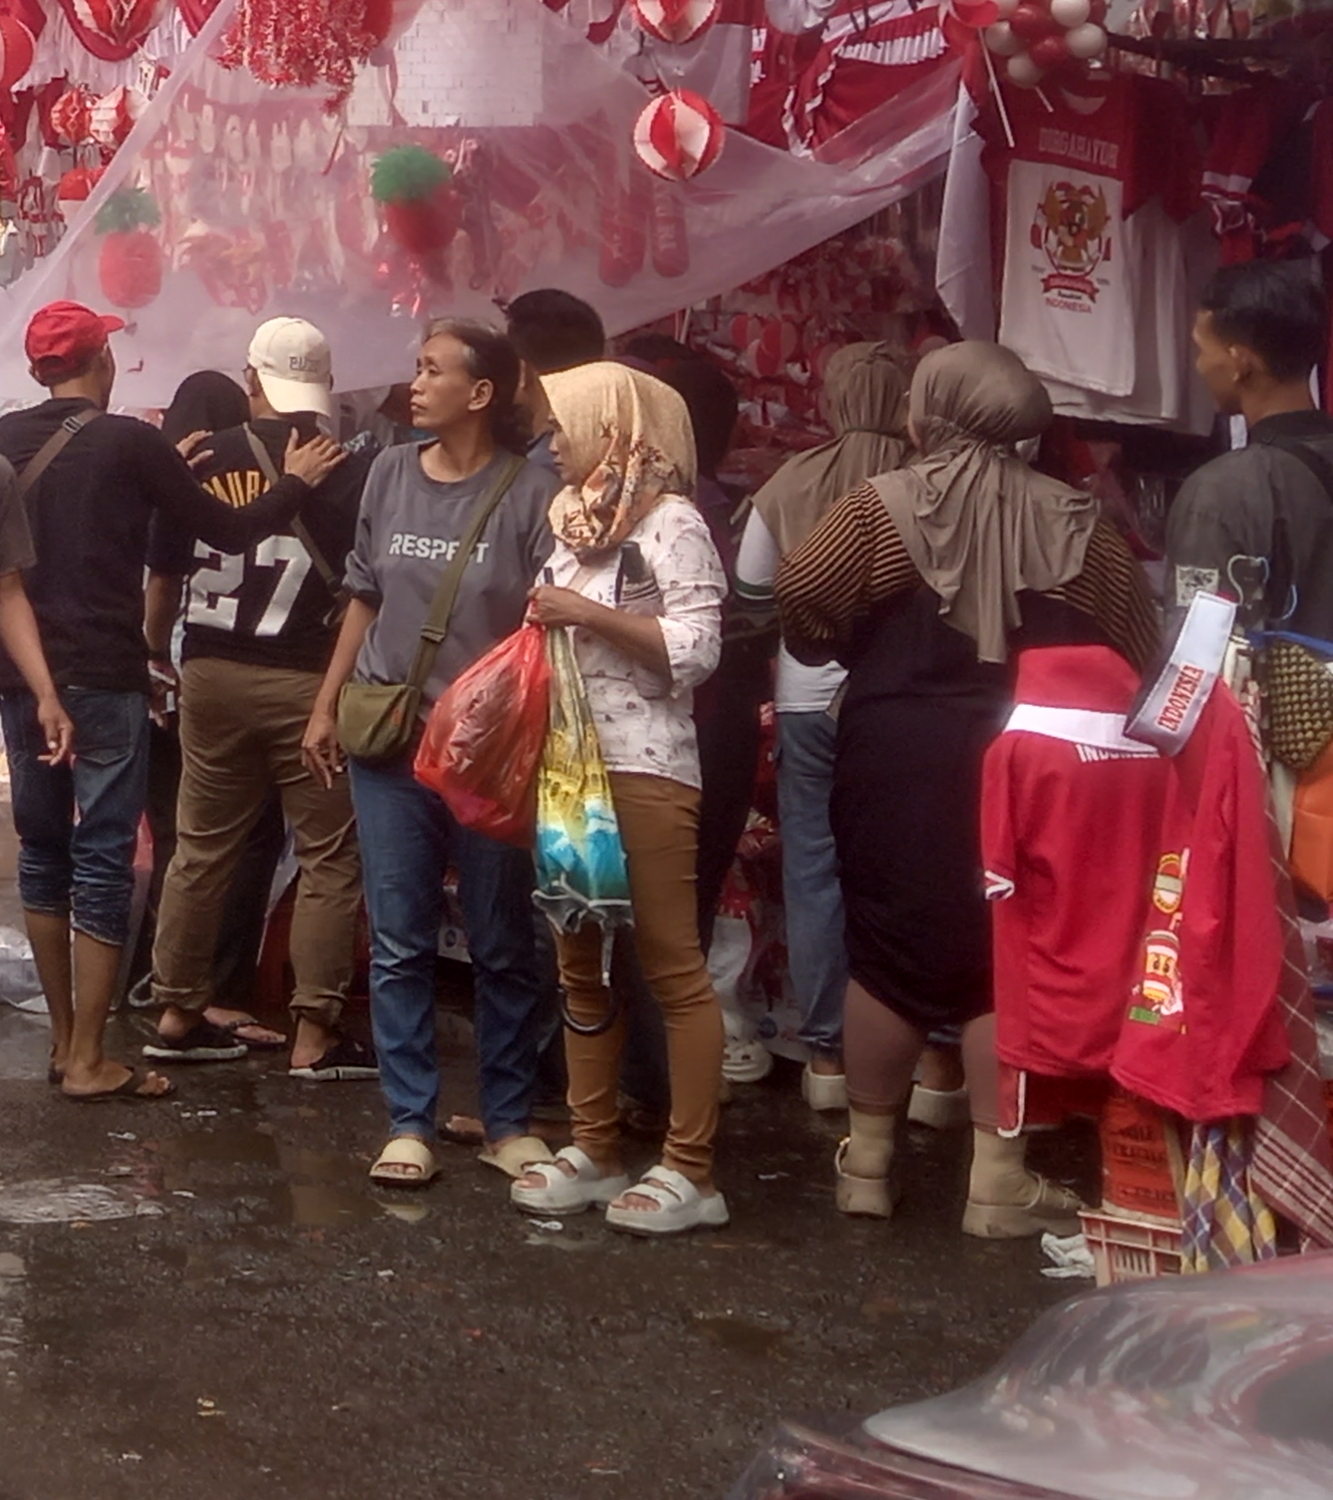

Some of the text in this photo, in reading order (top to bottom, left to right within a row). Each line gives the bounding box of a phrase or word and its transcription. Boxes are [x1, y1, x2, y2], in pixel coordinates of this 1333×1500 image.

[389, 533, 489, 563] RESPET
[186, 534, 313, 637] 27
[1156, 664, 1206, 733] INDONESIA
